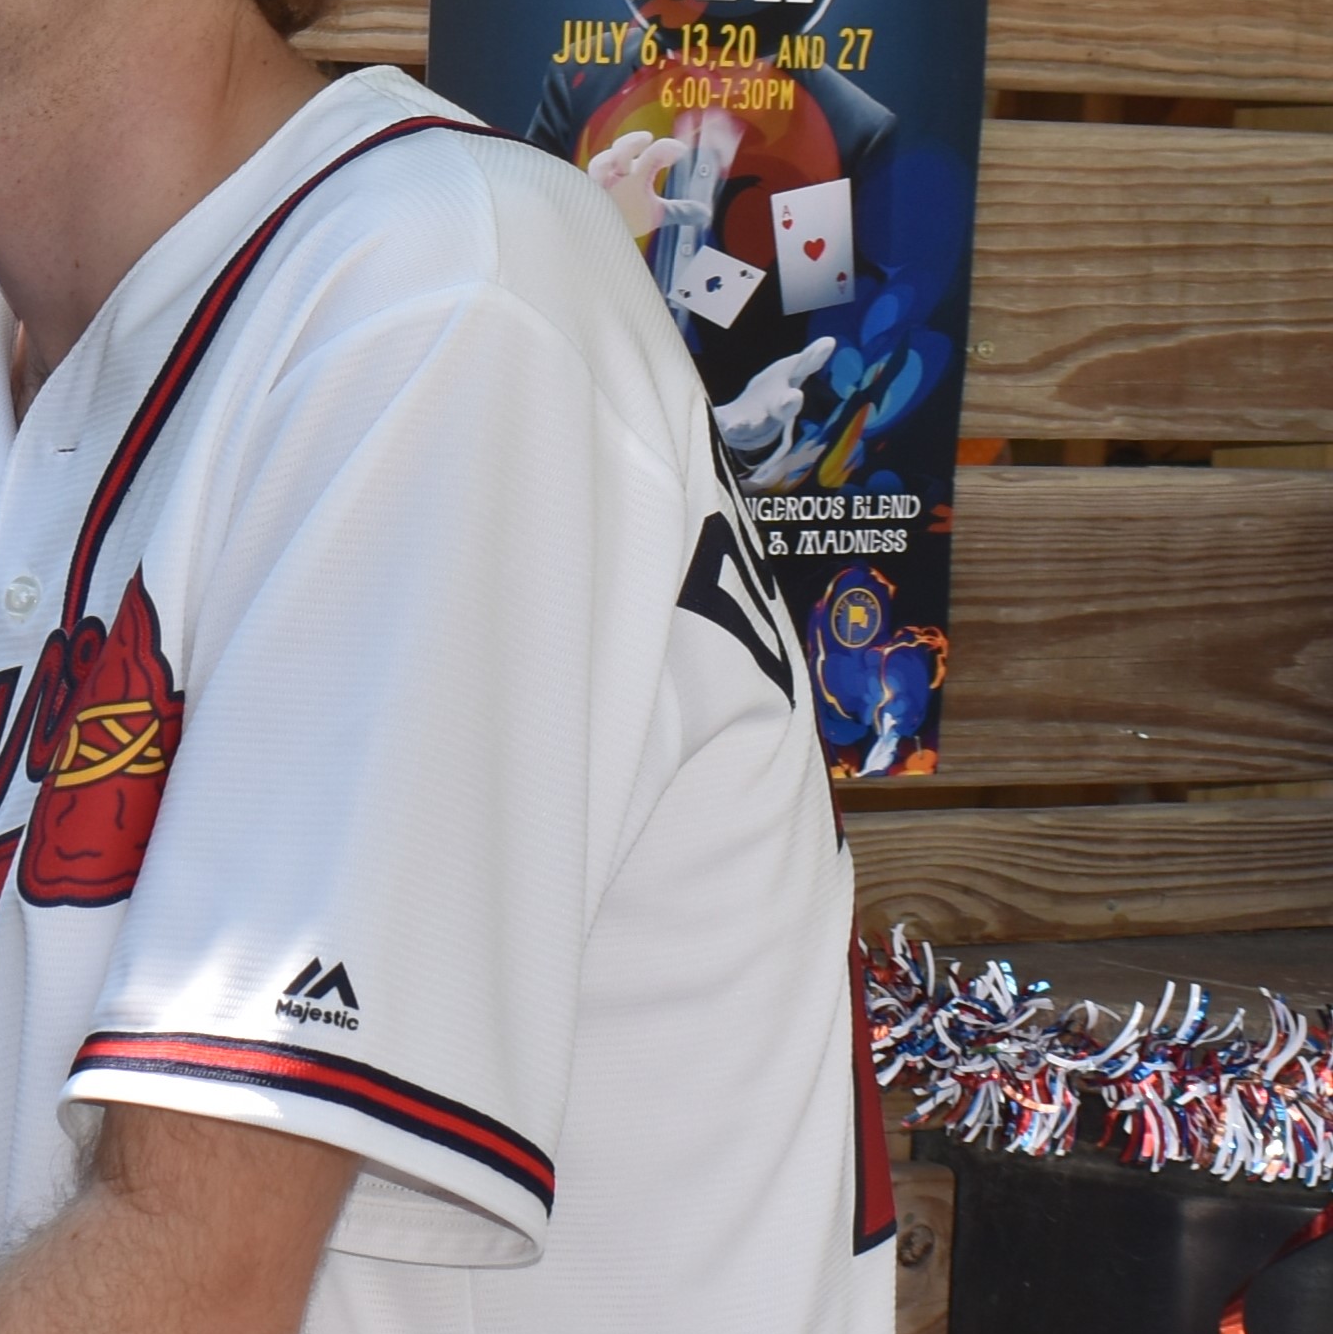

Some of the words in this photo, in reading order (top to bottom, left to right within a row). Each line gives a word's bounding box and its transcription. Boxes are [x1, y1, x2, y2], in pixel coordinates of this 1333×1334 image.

[552, 19, 630, 66] JULY
[639, 24, 668, 70] 6,
[777, 35, 826, 70] AND
[838, 28, 873, 71] 27
[660, 77, 795, 111] 6:00-7:30PM
[852, 495, 921, 520] BLEND
[768, 531, 789, 555] &
[795, 529, 908, 555] MADNESS
[276, 998, 359, 1031] Majestic
